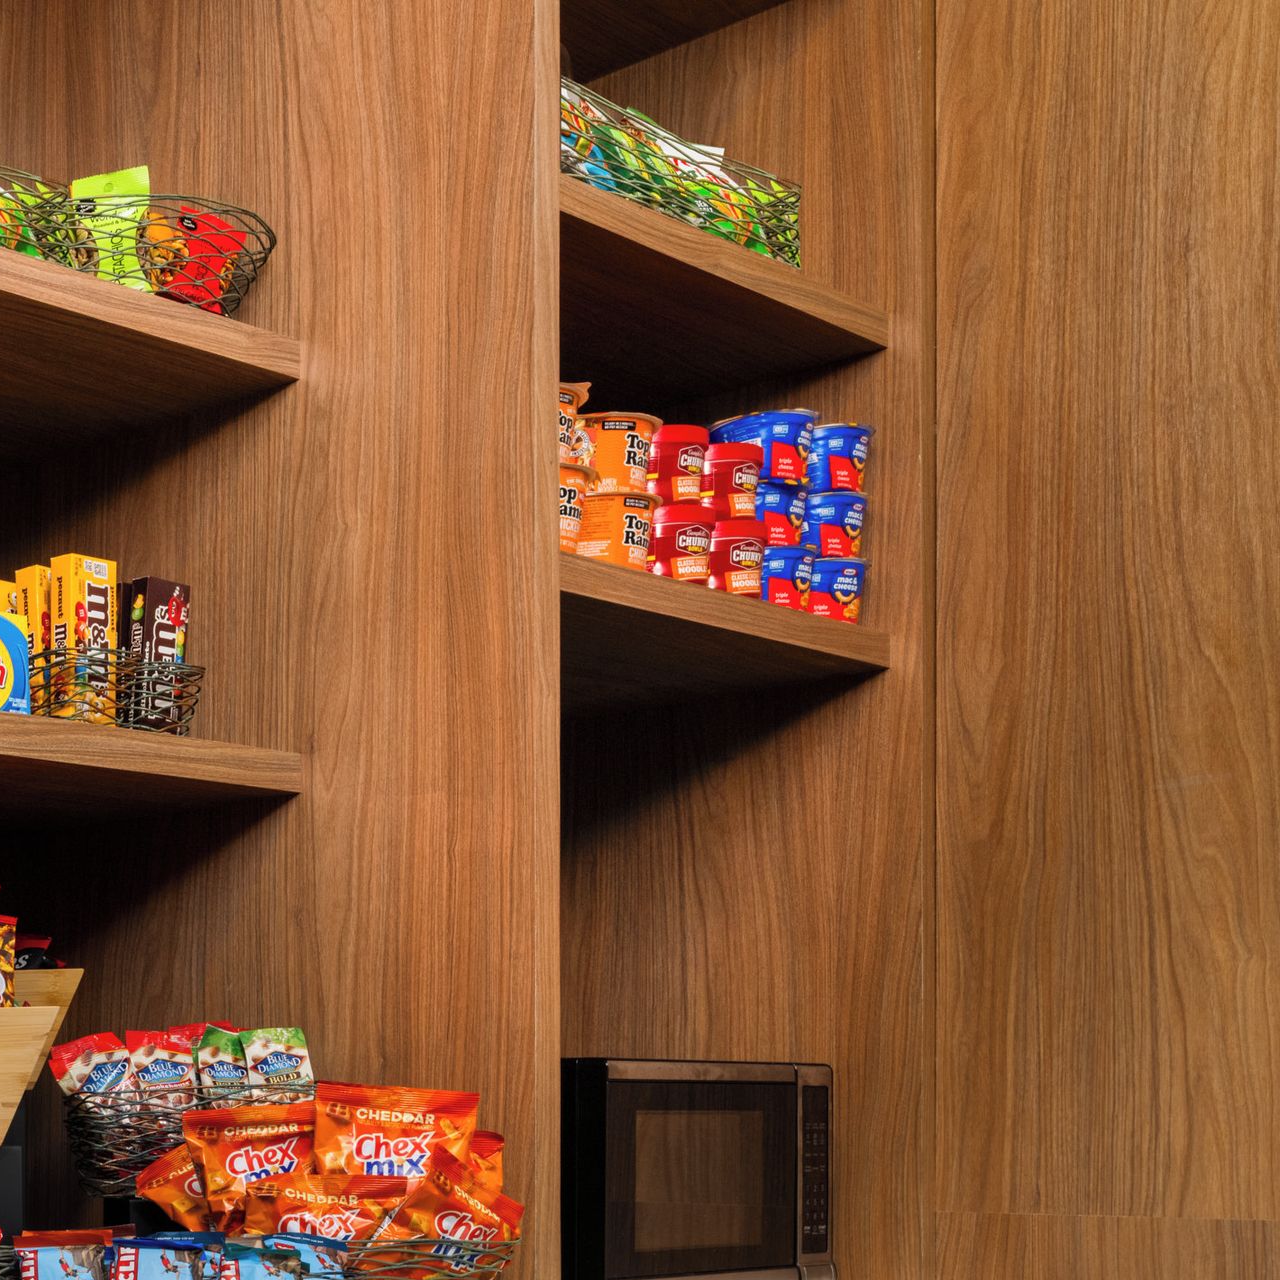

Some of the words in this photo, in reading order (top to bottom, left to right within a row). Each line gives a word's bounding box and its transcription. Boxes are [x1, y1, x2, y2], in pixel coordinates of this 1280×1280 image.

[626, 433, 650, 453] Top
[624, 514, 650, 534] Top
[679, 535, 709, 547] CHUNKY
[732, 550, 762, 562] CHUNKY
[148, 1061, 173, 1074] BLUE
[212, 1061, 234, 1071] BLUE
[257, 1056, 301, 1074] DIAMOND
[266, 1051, 288, 1066] BLUE
[82, 1061, 129, 1093] DIAMOND
[90, 1061, 113, 1081] BLUE
[138, 1066, 189, 1082] DIAMOND
[205, 1067, 247, 1079] DIAMOND
[268, 1072, 298, 1084] BOLD
[356, 1107, 436, 1126] CHEDDAR
[223, 1122, 299, 1138] CHEDDAR
[354, 1131, 437, 1163] Chex
[225, 1137, 302, 1178] Chex
[363, 1153, 428, 1177] mix
[284, 1187, 359, 1205] CHEDDAR
[454, 1184, 501, 1222] CHEDDAR
[277, 1207, 362, 1242] Chex
[434, 1209, 500, 1253] Chex
